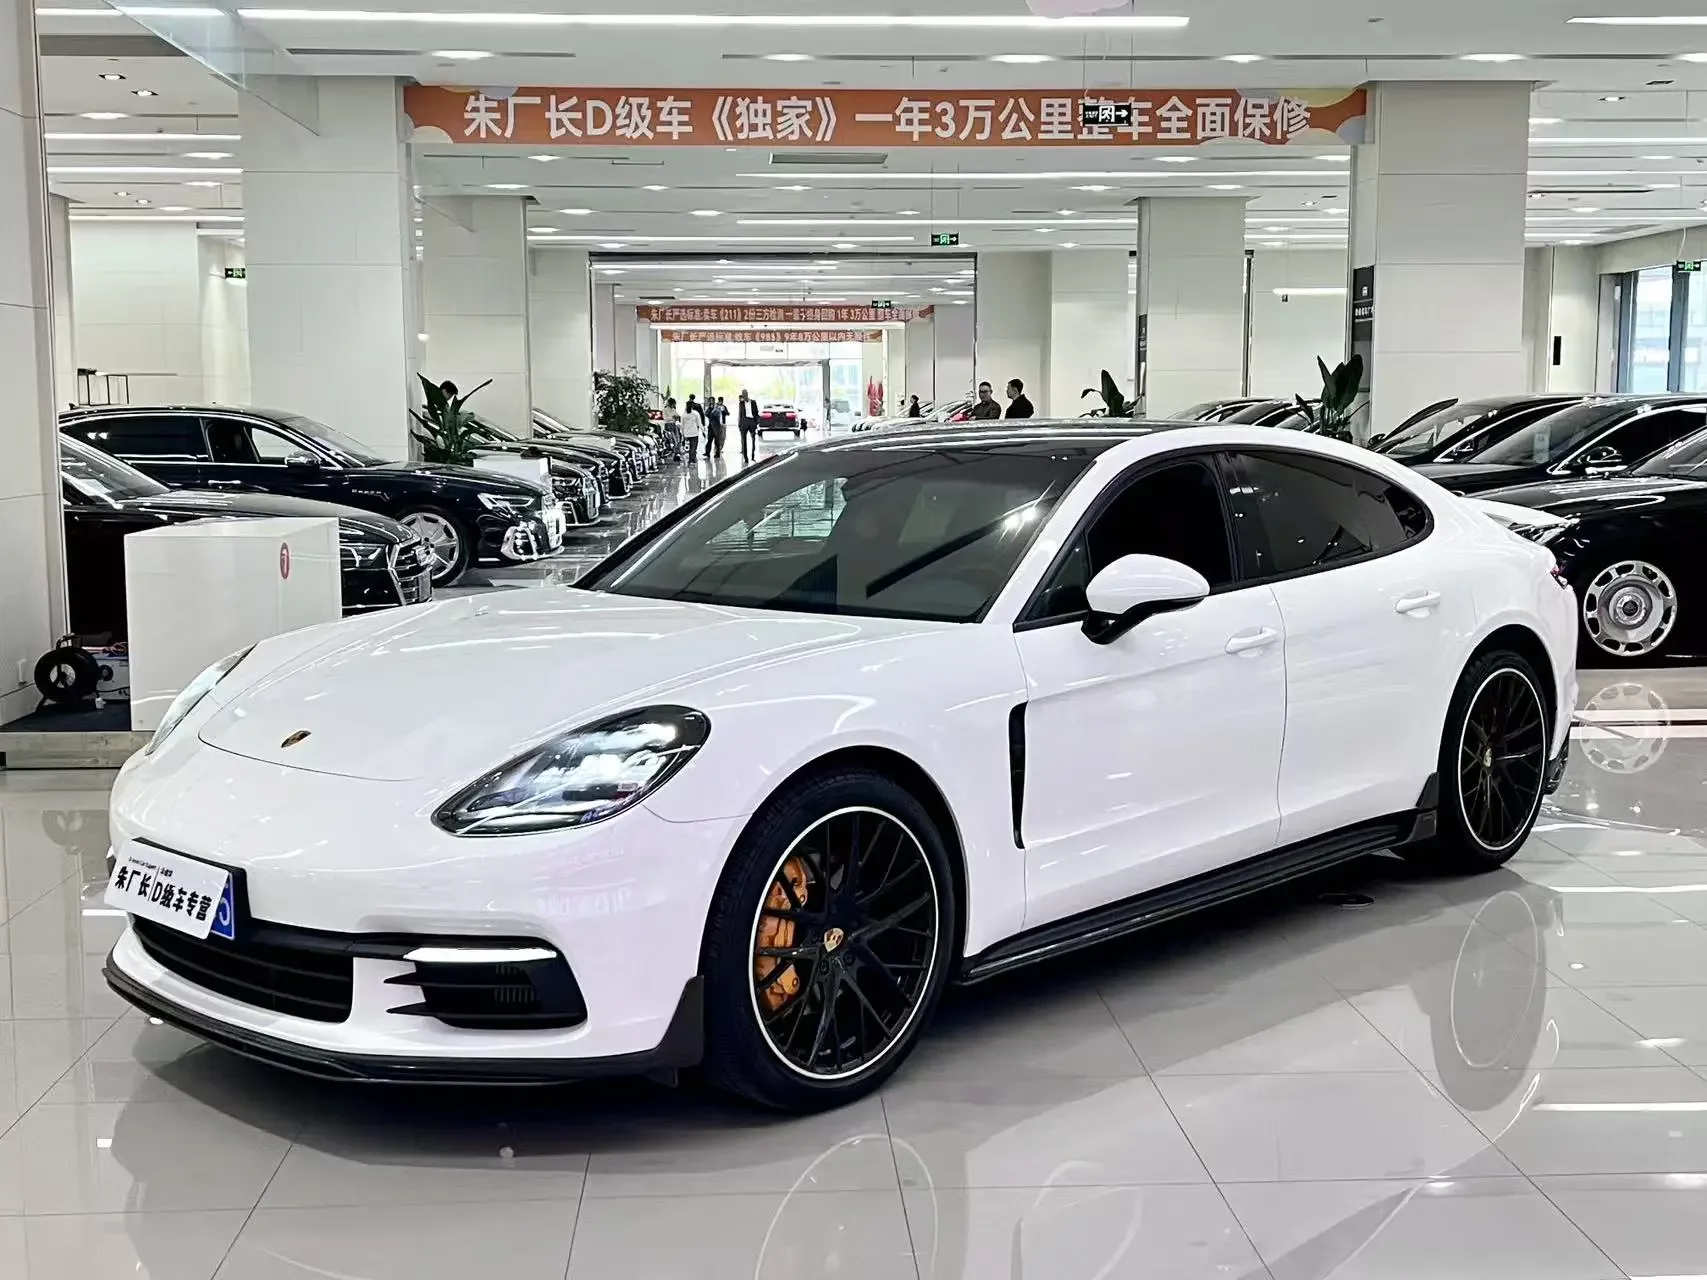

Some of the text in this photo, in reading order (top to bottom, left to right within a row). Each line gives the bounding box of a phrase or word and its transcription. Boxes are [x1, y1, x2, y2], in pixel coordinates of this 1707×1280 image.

[115, 866, 212, 921] 朱厂长 D级车专营
